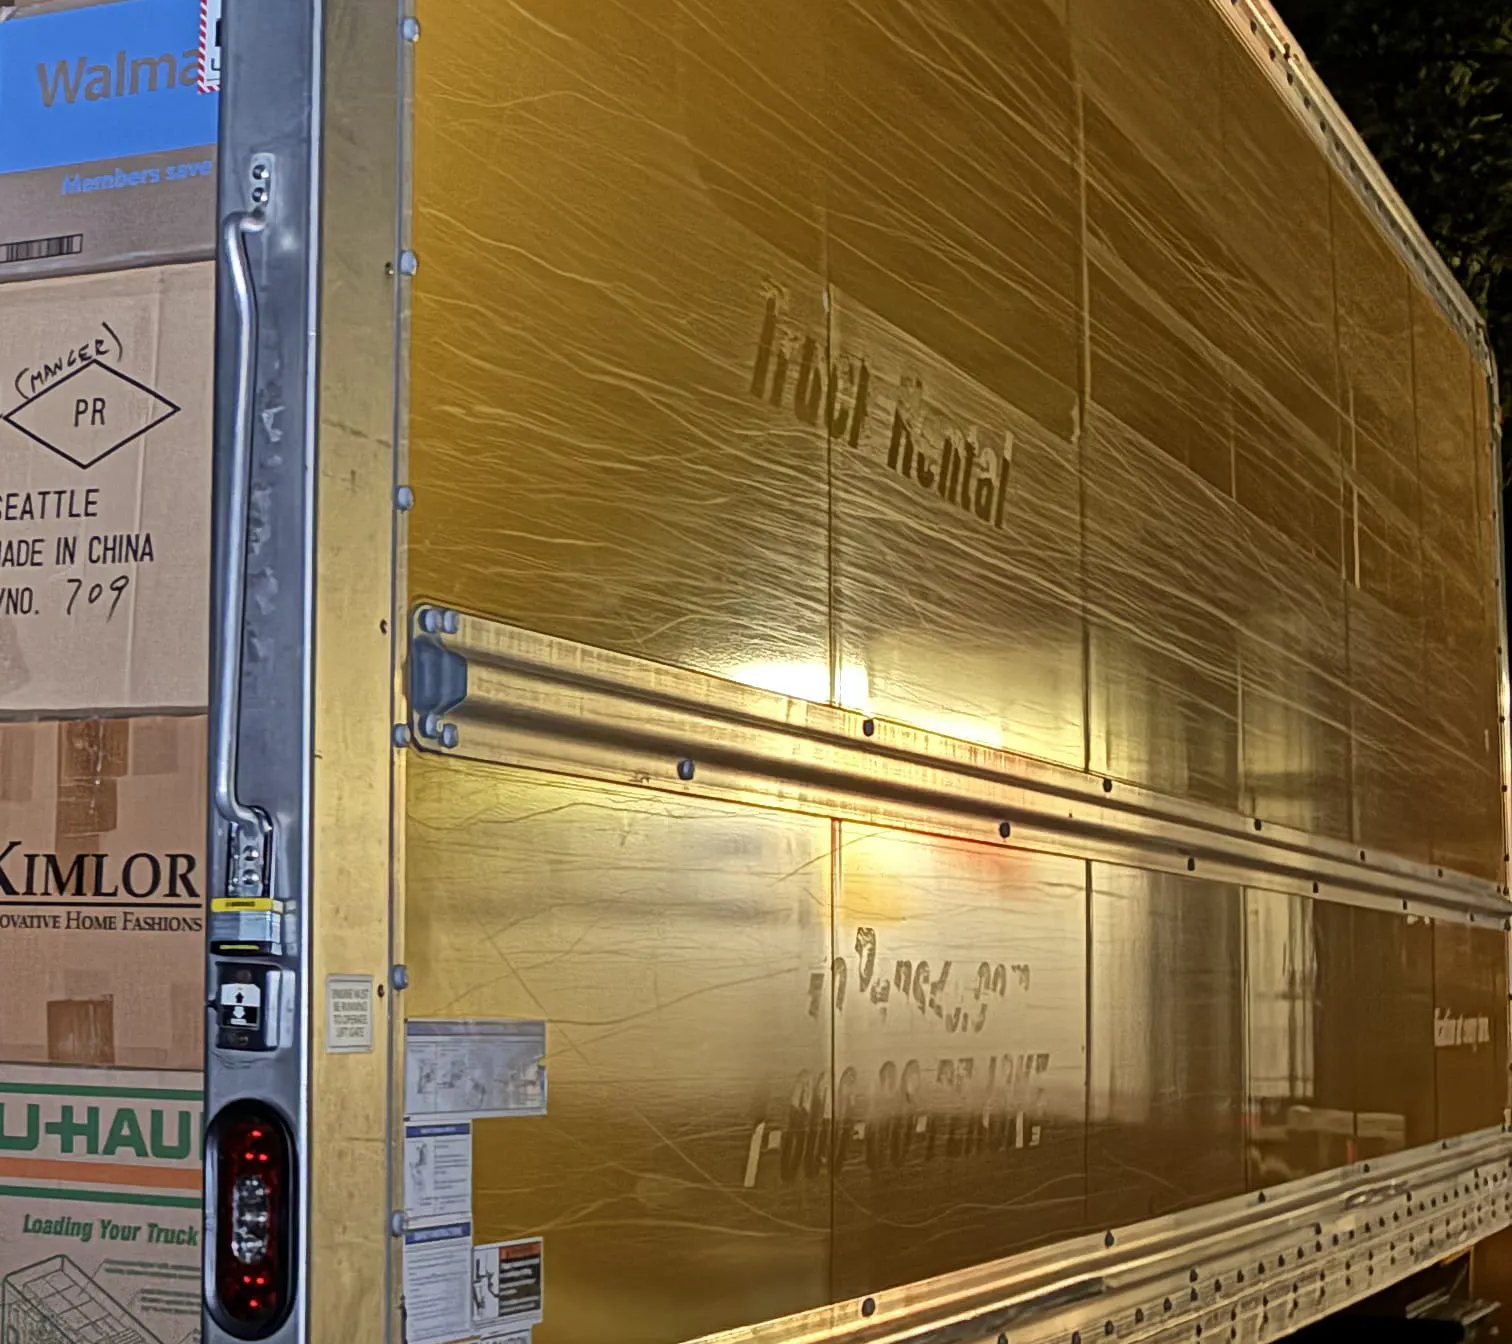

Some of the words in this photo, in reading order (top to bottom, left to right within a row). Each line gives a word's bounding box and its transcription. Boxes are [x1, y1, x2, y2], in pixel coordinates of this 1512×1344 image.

[60, 168, 161, 195] Members
[164, 159, 214, 181] save
[73, 397, 107, 427] PR
[55, 536, 76, 566] IN
[88, 533, 155, 564] CHINA
[66, 575, 130, 623] 709
[23, 1214, 92, 1241] Loading
[100, 1218, 141, 1241] Your
[147, 1223, 199, 1246] Truck
